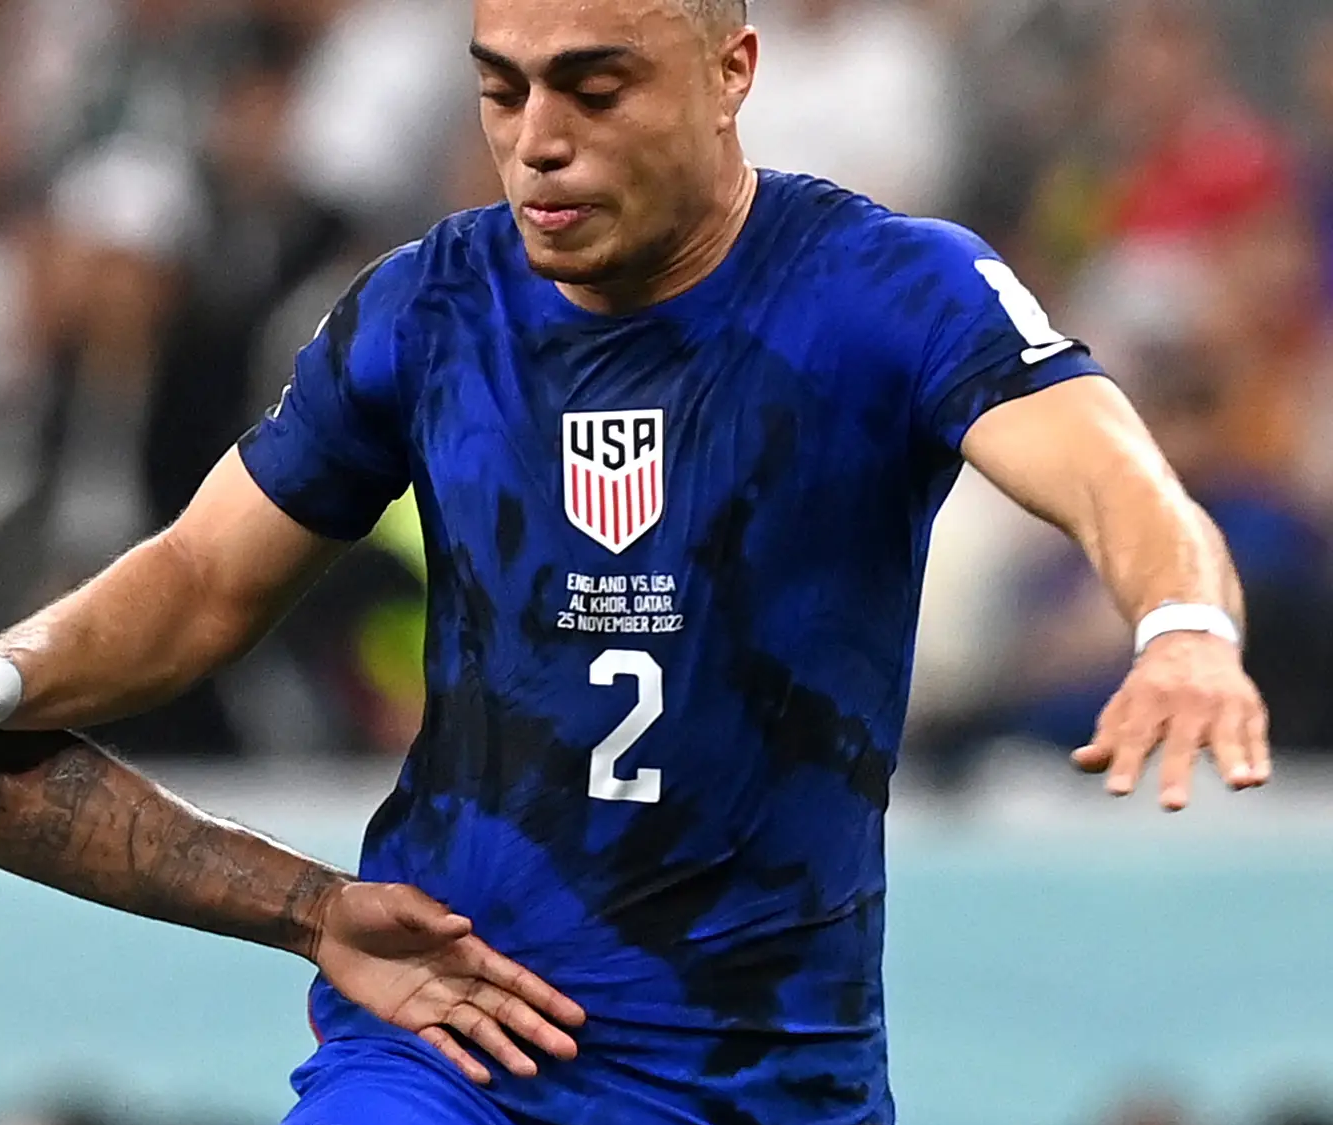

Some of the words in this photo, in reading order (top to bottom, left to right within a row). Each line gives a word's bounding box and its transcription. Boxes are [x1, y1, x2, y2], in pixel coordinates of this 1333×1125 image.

[571, 418, 656, 471] USA
[566, 573, 627, 593] ENGLAND
[630, 575, 650, 592] VS.
[651, 575, 676, 592] USA
[569, 594, 587, 612] AL
[590, 596, 631, 614] KHOR,
[557, 611, 575, 629] 25
[578, 615, 650, 632] NOVEMBER
[652, 614, 684, 633] 2022
[588, 649, 664, 803] 2
